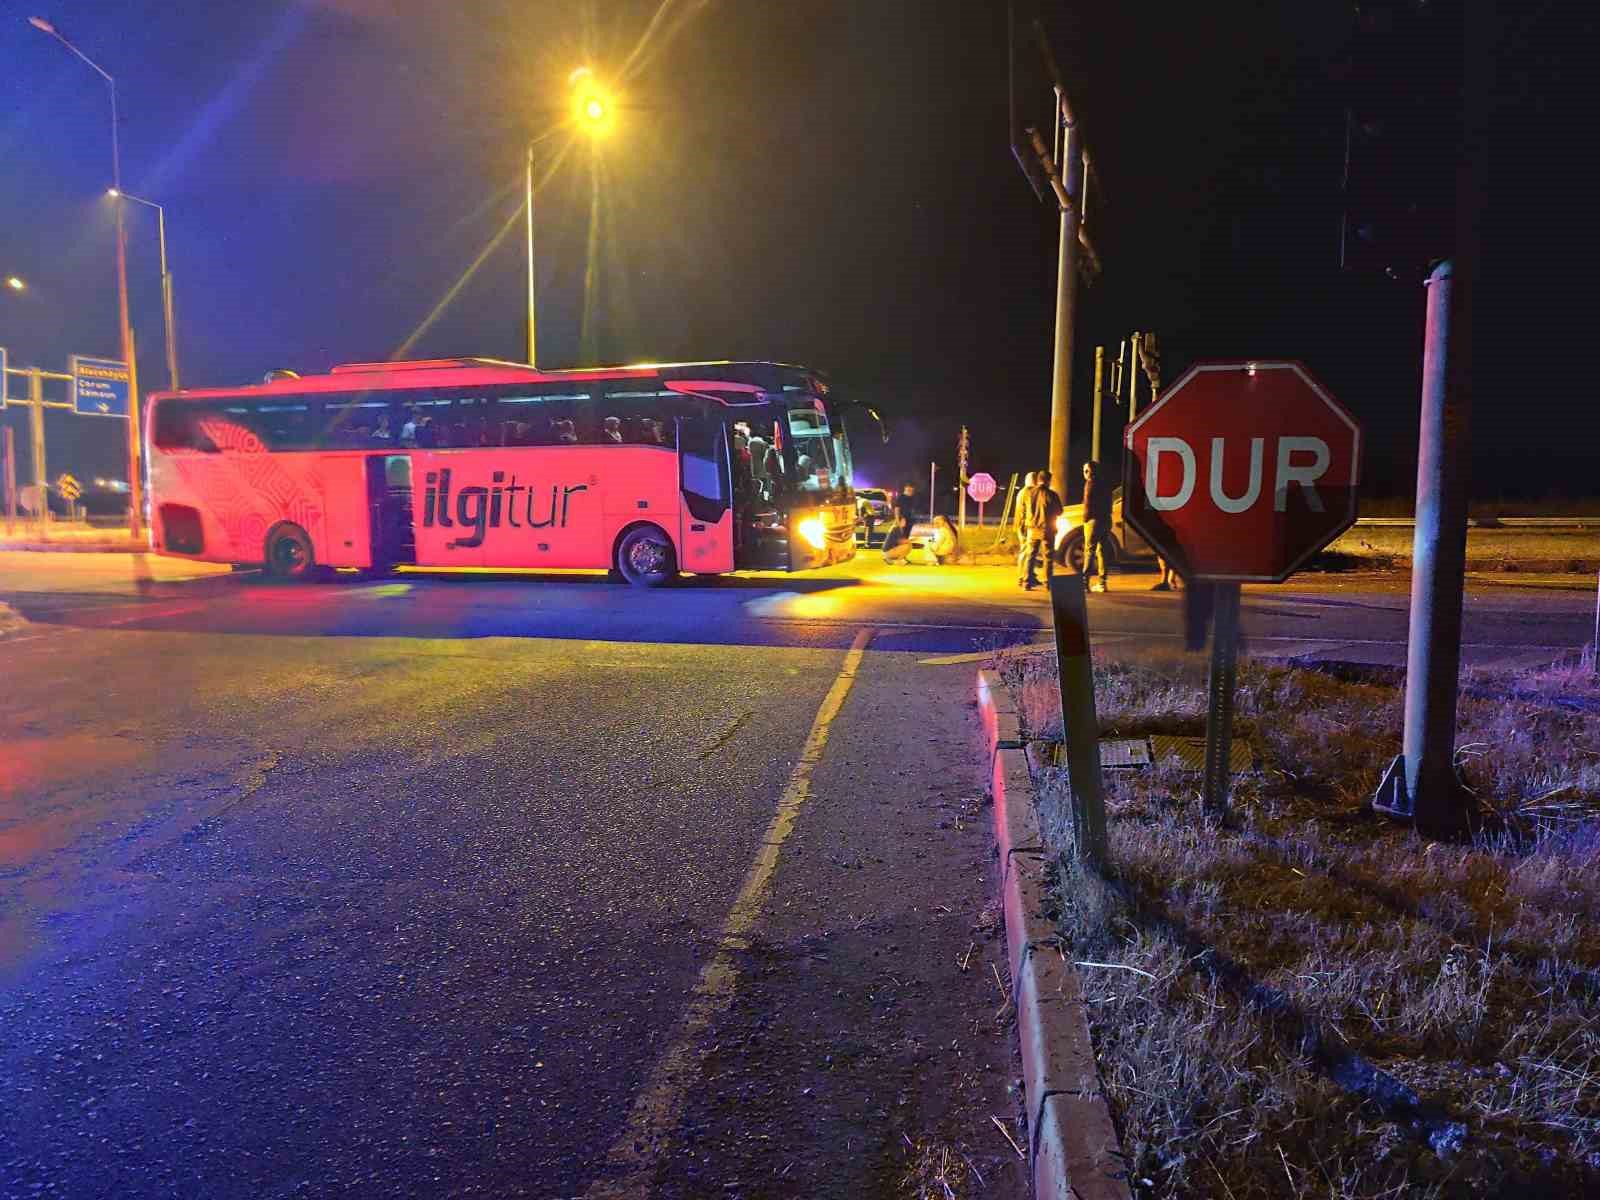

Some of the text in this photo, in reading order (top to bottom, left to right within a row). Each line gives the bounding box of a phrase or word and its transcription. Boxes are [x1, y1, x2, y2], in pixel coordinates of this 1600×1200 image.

[423, 468, 588, 547] ilgitur
[970, 481, 993, 494] DUR
[1144, 436, 1331, 514] DUR
